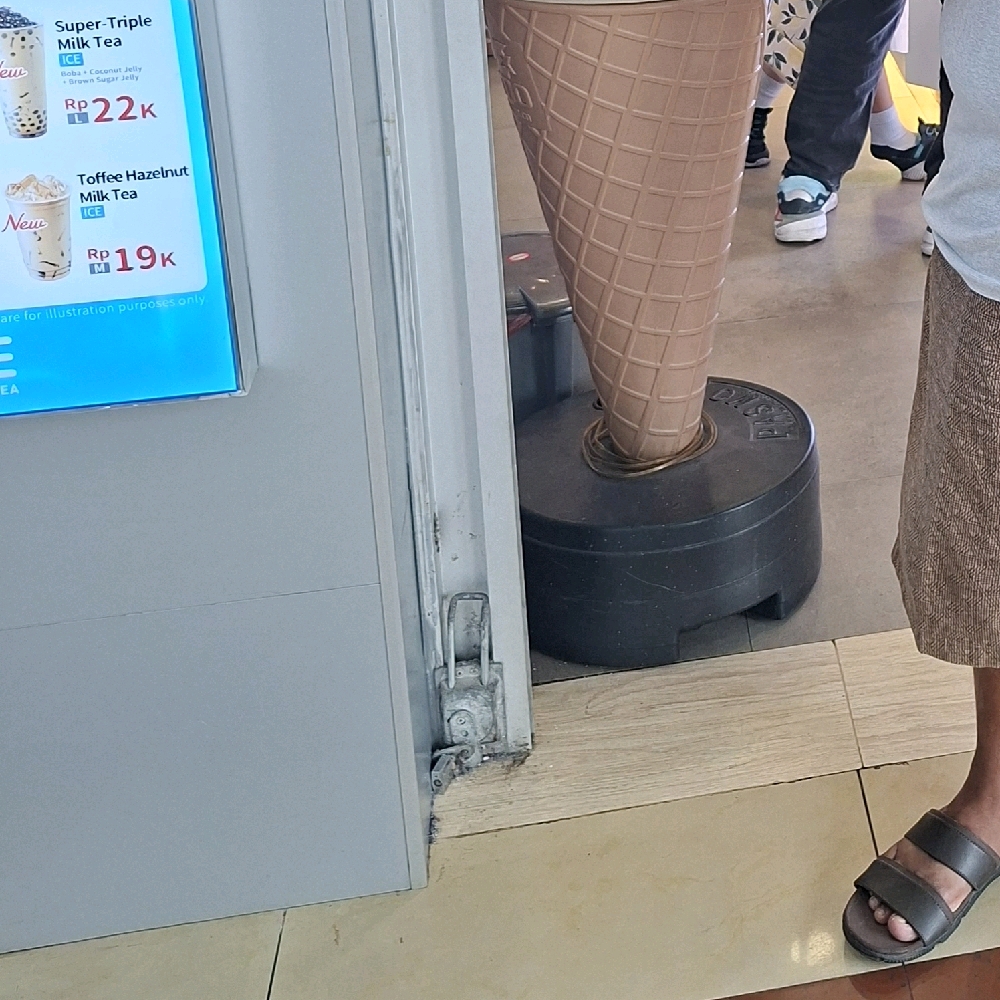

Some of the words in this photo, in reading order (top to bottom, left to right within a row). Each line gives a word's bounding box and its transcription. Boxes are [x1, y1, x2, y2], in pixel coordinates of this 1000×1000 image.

[54, 14, 153, 34] Super-Triple
[57, 36, 91, 50] Milk
[93, 36, 123, 48] Tea
[62, 53, 82, 65] ICE
[0, 64, 28, 79] ew
[124, 65, 142, 73] Jelly
[96, 75, 118, 84] Sugar
[65, 98, 89, 112] Rp
[92, 95, 158, 123] 22K
[77, 172, 123, 186] Toffee
[126, 165, 190, 181] Hazelnut
[79, 190, 110, 203] Milk
[112, 189, 138, 200] Tea
[83, 206, 102, 218] ICE
[2, 213, 48, 233] New
[87, 248, 110, 262] Rp
[115, 245, 177, 273] 19K
[1, 313, 20, 323] are
[24, 310, 41, 321] for
[46, 304, 115, 319] illustration
[118, 298, 175, 314] purposes
[1, 384, 20, 395] EA
